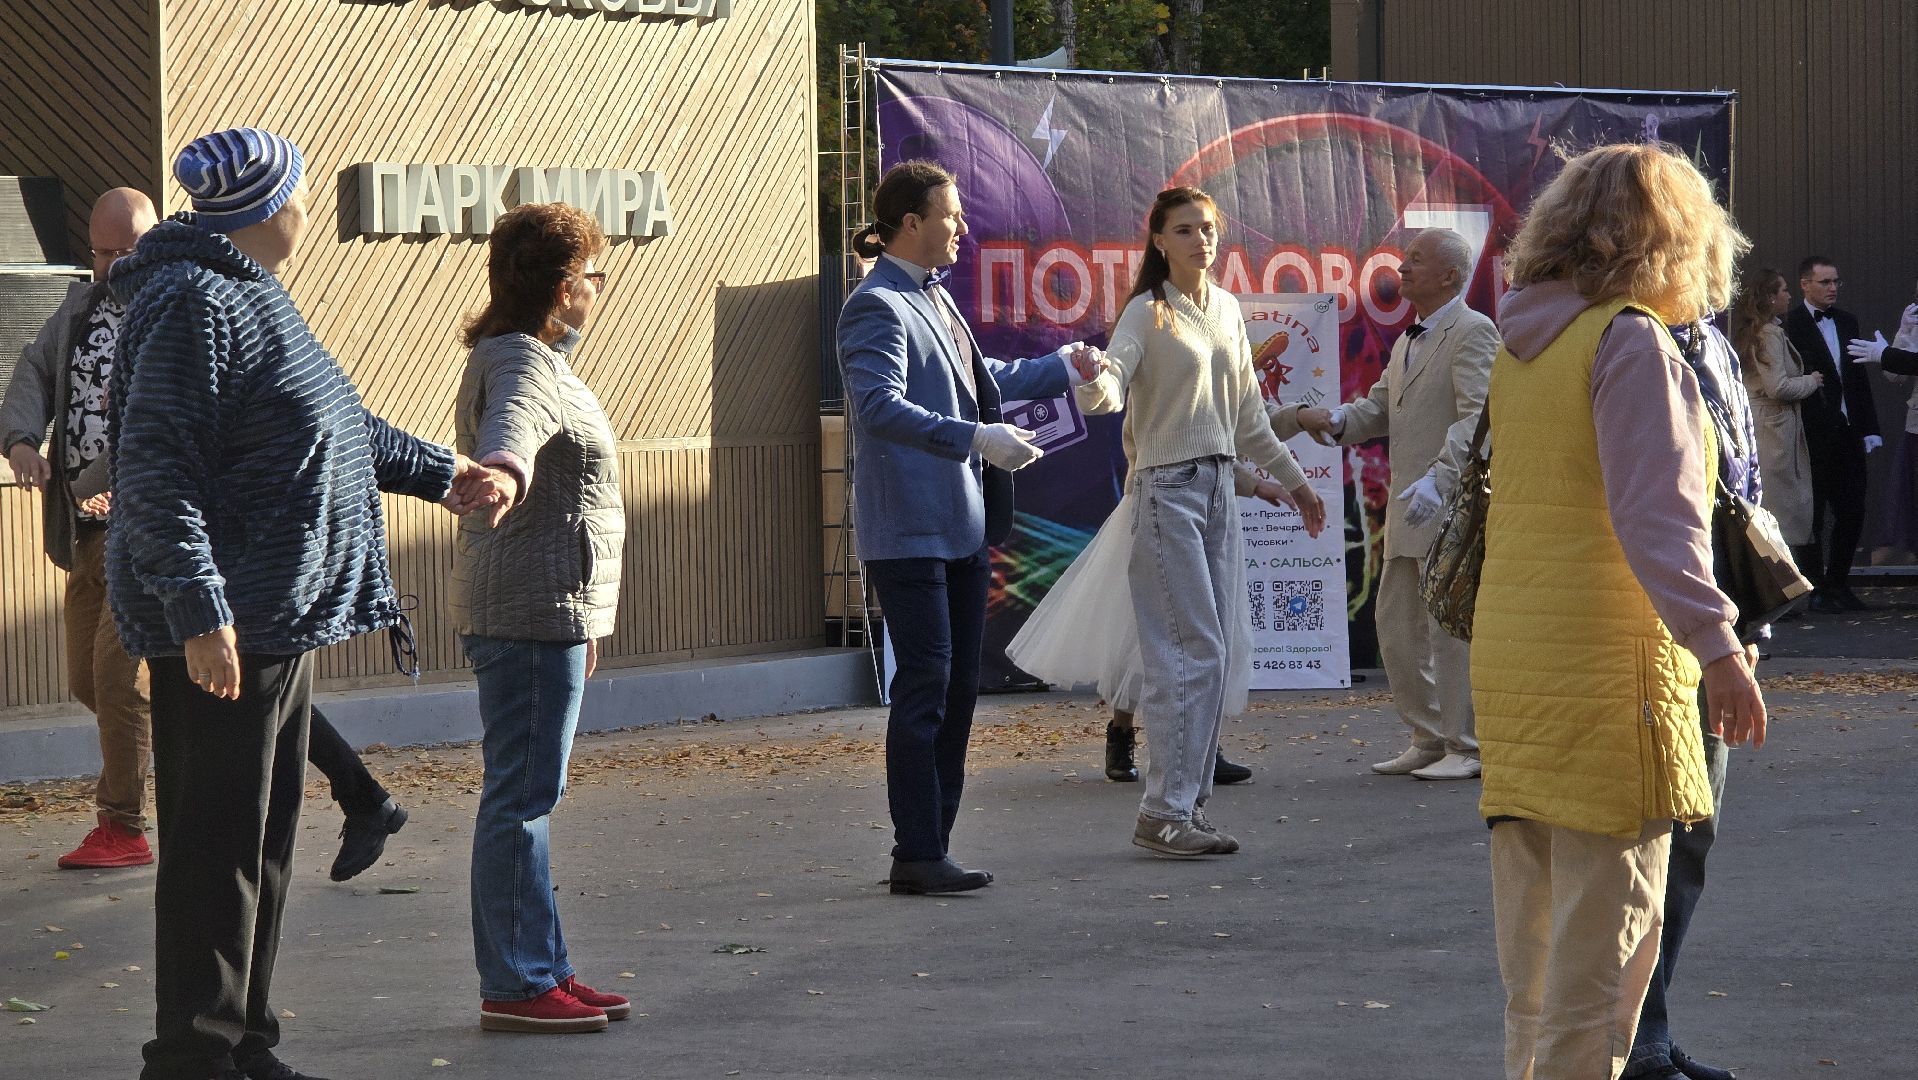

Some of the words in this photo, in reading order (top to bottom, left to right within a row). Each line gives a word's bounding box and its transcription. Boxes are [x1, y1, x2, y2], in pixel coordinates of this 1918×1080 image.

[360, 162, 512, 235] ПАРК
[527, 166, 675, 237] МИРА
[1244, 310, 1320, 354] atina
[1259, 510, 1302, 520] Практи
[1246, 538, 1288, 548] Тусовки
[1269, 556, 1334, 569] САЛЬСА
[1263, 660, 1287, 670] 426
[1288, 660, 1303, 670] 83
[1305, 659, 1322, 670] 43
[1157, 823, 1181, 844] N
